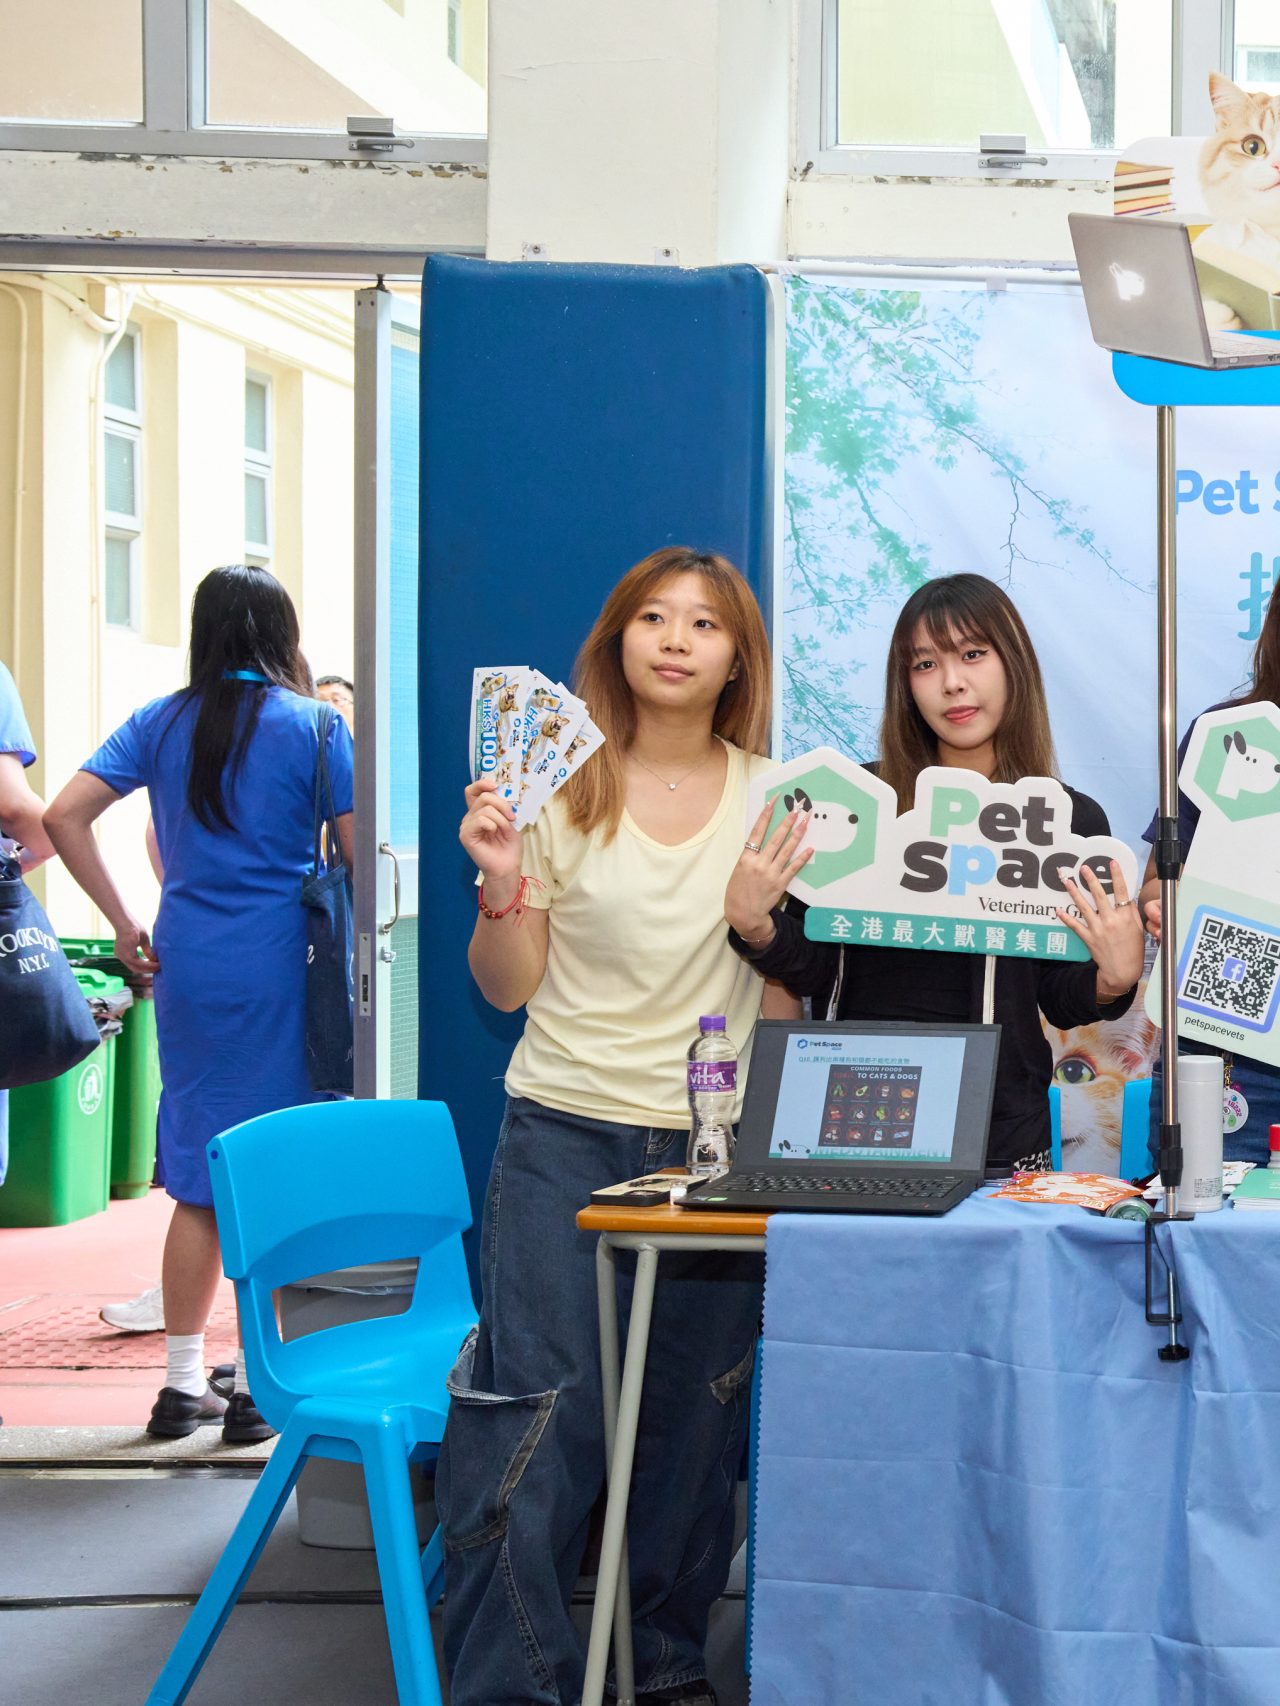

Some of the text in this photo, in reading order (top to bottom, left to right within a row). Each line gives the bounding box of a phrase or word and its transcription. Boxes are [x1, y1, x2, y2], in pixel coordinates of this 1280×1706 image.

[1175, 469, 1261, 516] Pet
[929, 786, 1055, 847] Pet
[899, 841, 1115, 896] Space
[978, 897, 1059, 919] Veterinary
[829, 913, 1069, 956] 全港最大獸醫集團
[1184, 1015, 1246, 1042] petspacevets
[690, 1064, 726, 1085] vita
